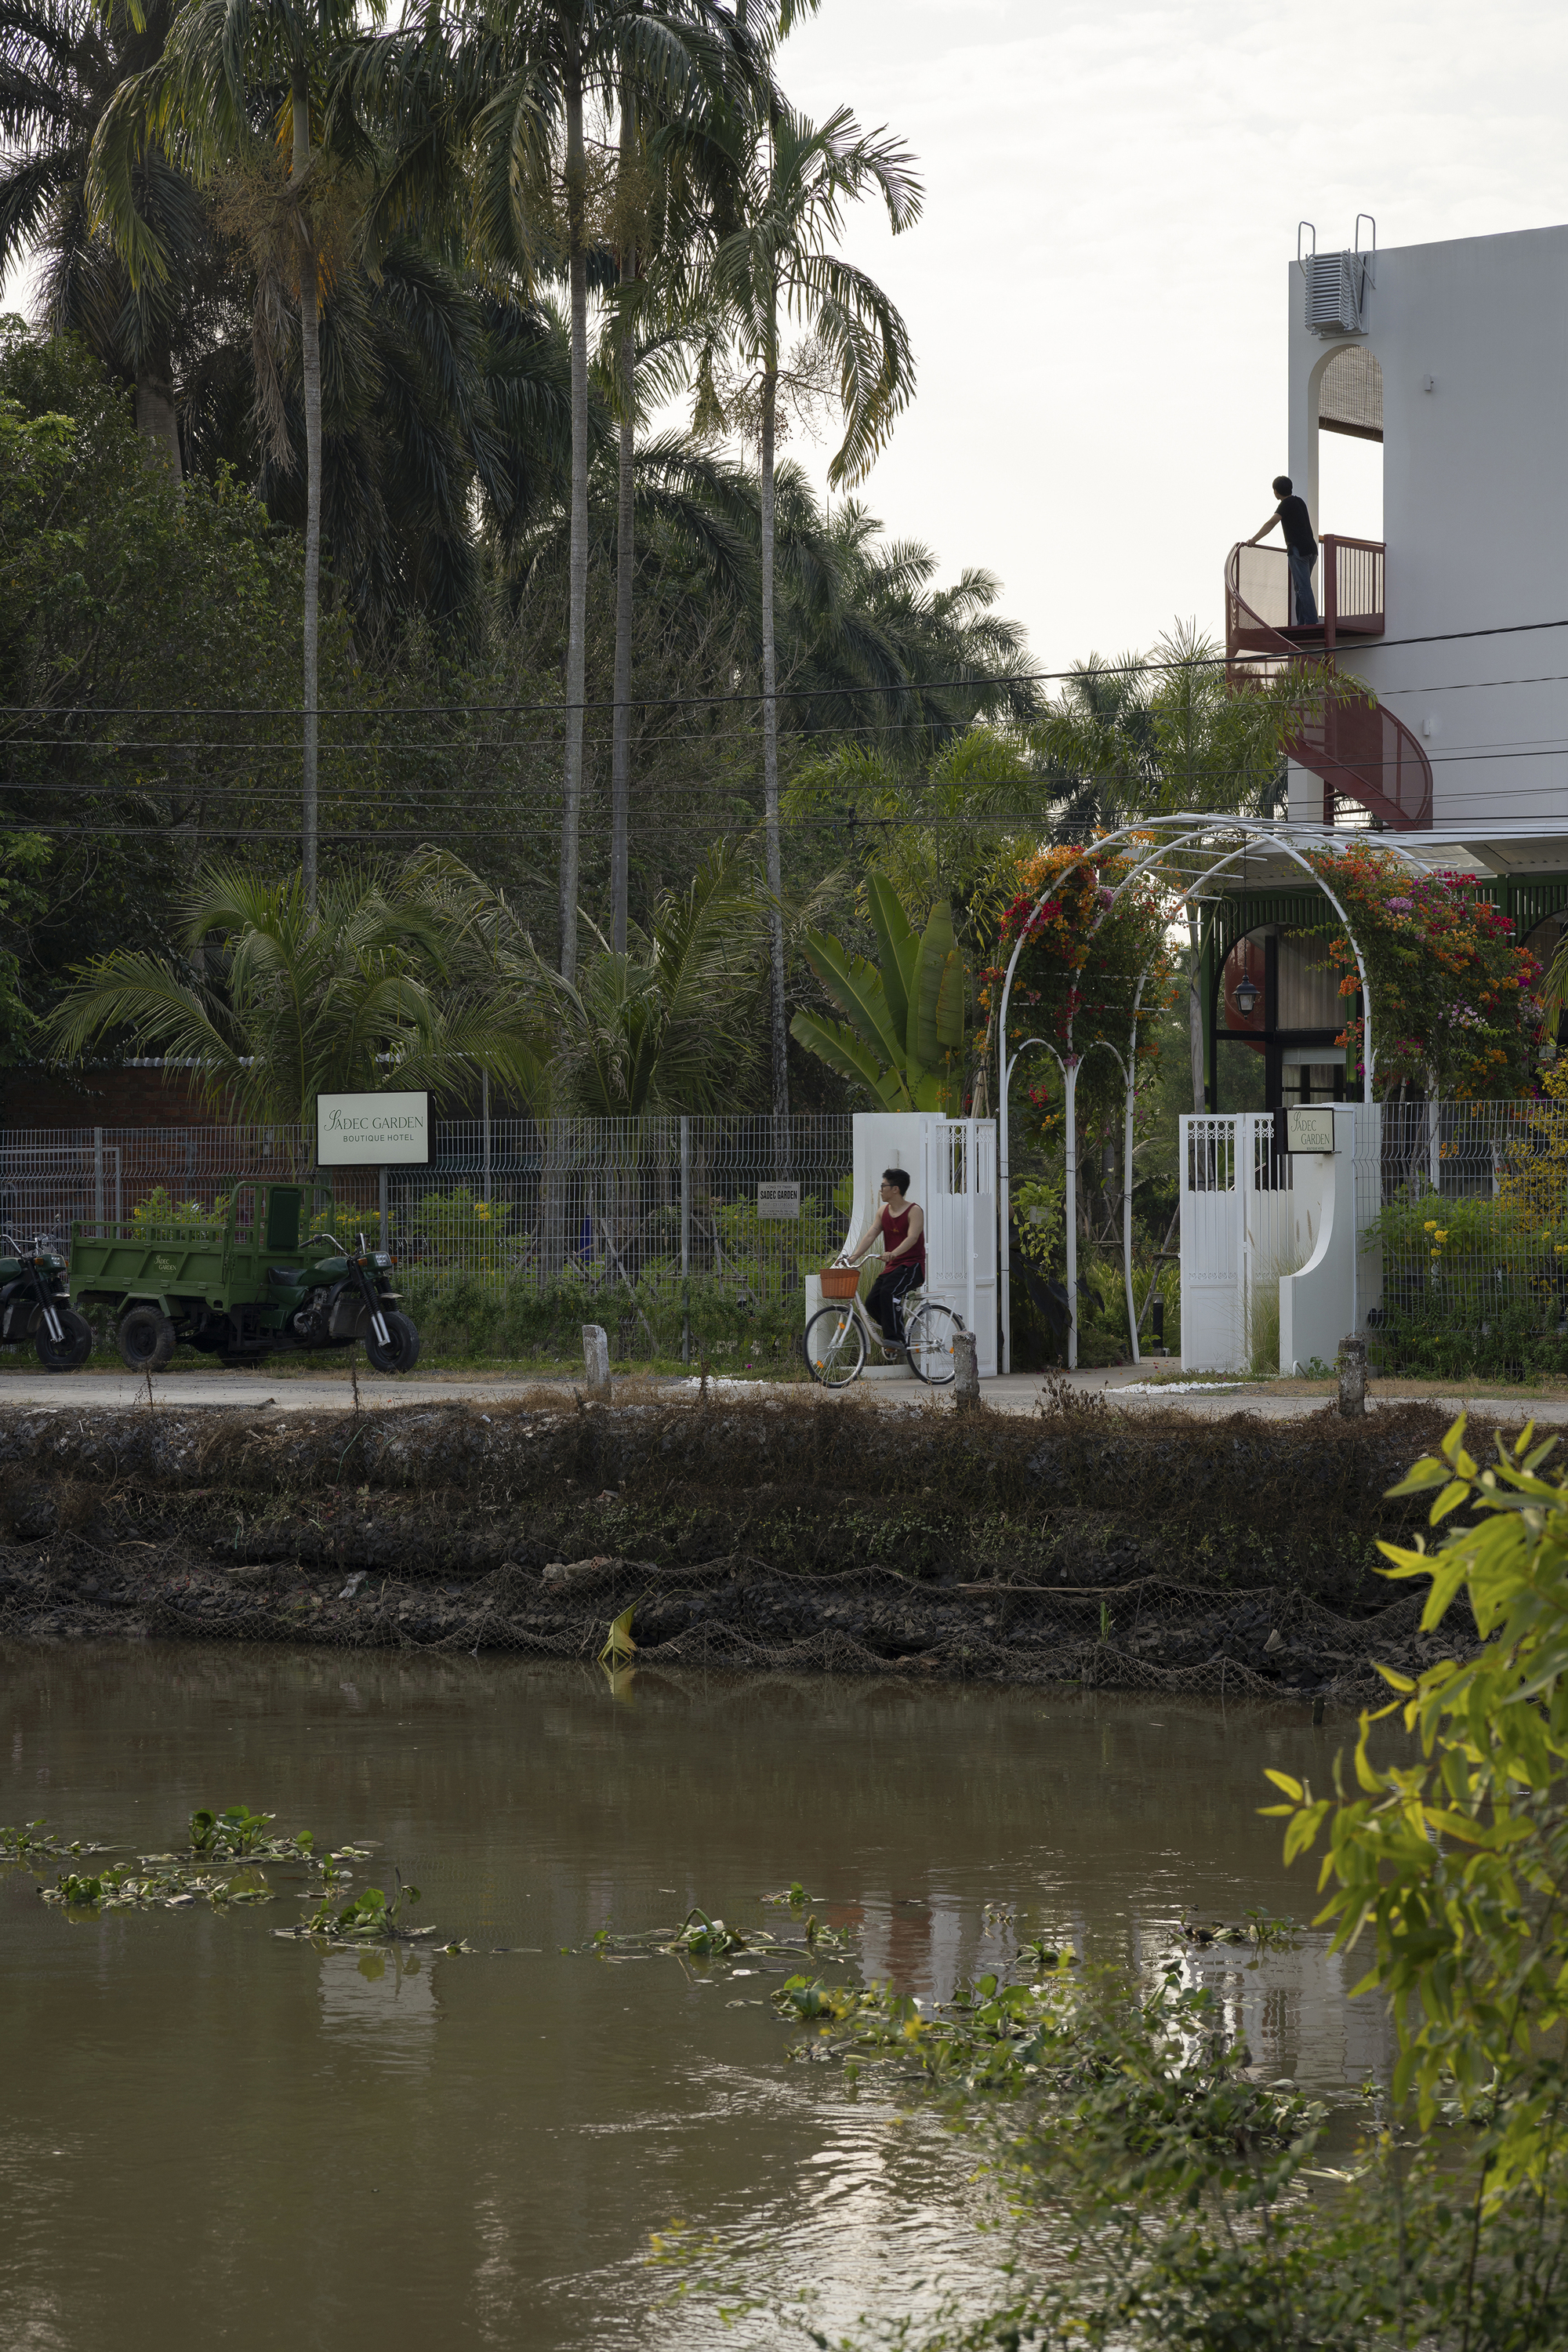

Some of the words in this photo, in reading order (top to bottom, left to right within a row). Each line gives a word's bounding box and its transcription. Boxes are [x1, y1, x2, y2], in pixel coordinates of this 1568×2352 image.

[372, 1116, 423, 1129] GARDEN
[1301, 1134, 1330, 1145] GARDEN
[760, 1190, 776, 1200] SADEC
[777, 1190, 797, 1200] GARDEN
